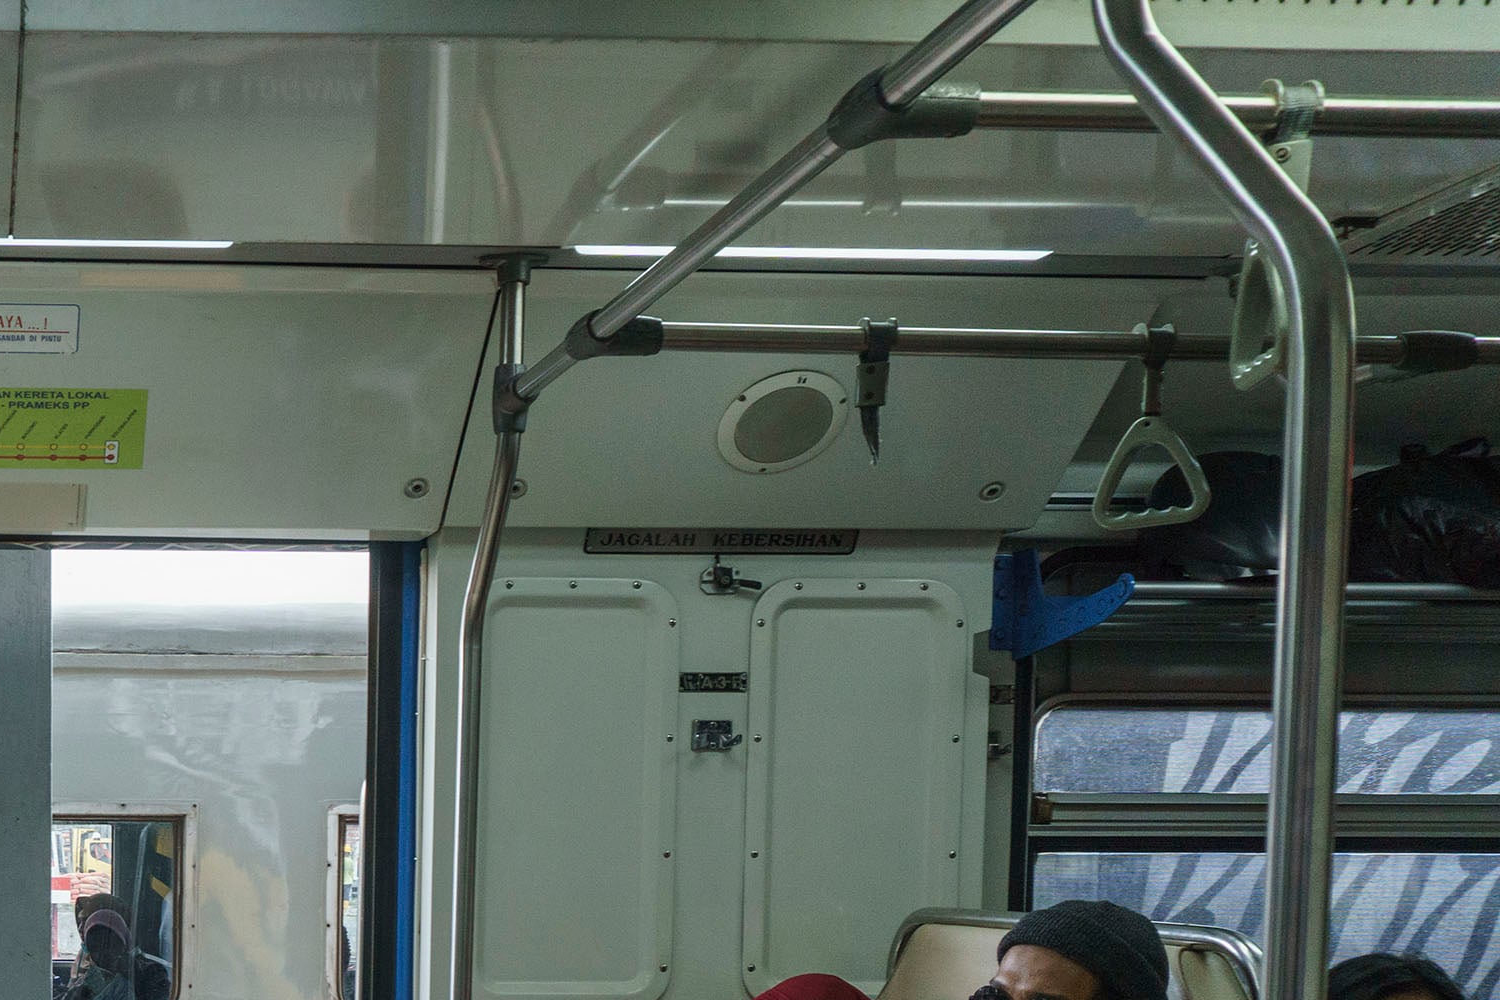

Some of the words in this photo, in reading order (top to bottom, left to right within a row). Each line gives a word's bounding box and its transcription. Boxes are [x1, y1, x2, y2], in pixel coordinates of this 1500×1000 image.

[40, 335, 62, 343] PINTU
[14, 390, 65, 399] KERETA
[67, 391, 110, 400] LOKAL
[8, 401, 70, 409] PRAMEKS
[599, 532, 697, 547] JAGALAH
[712, 533, 844, 548] KEBERSIHAN
